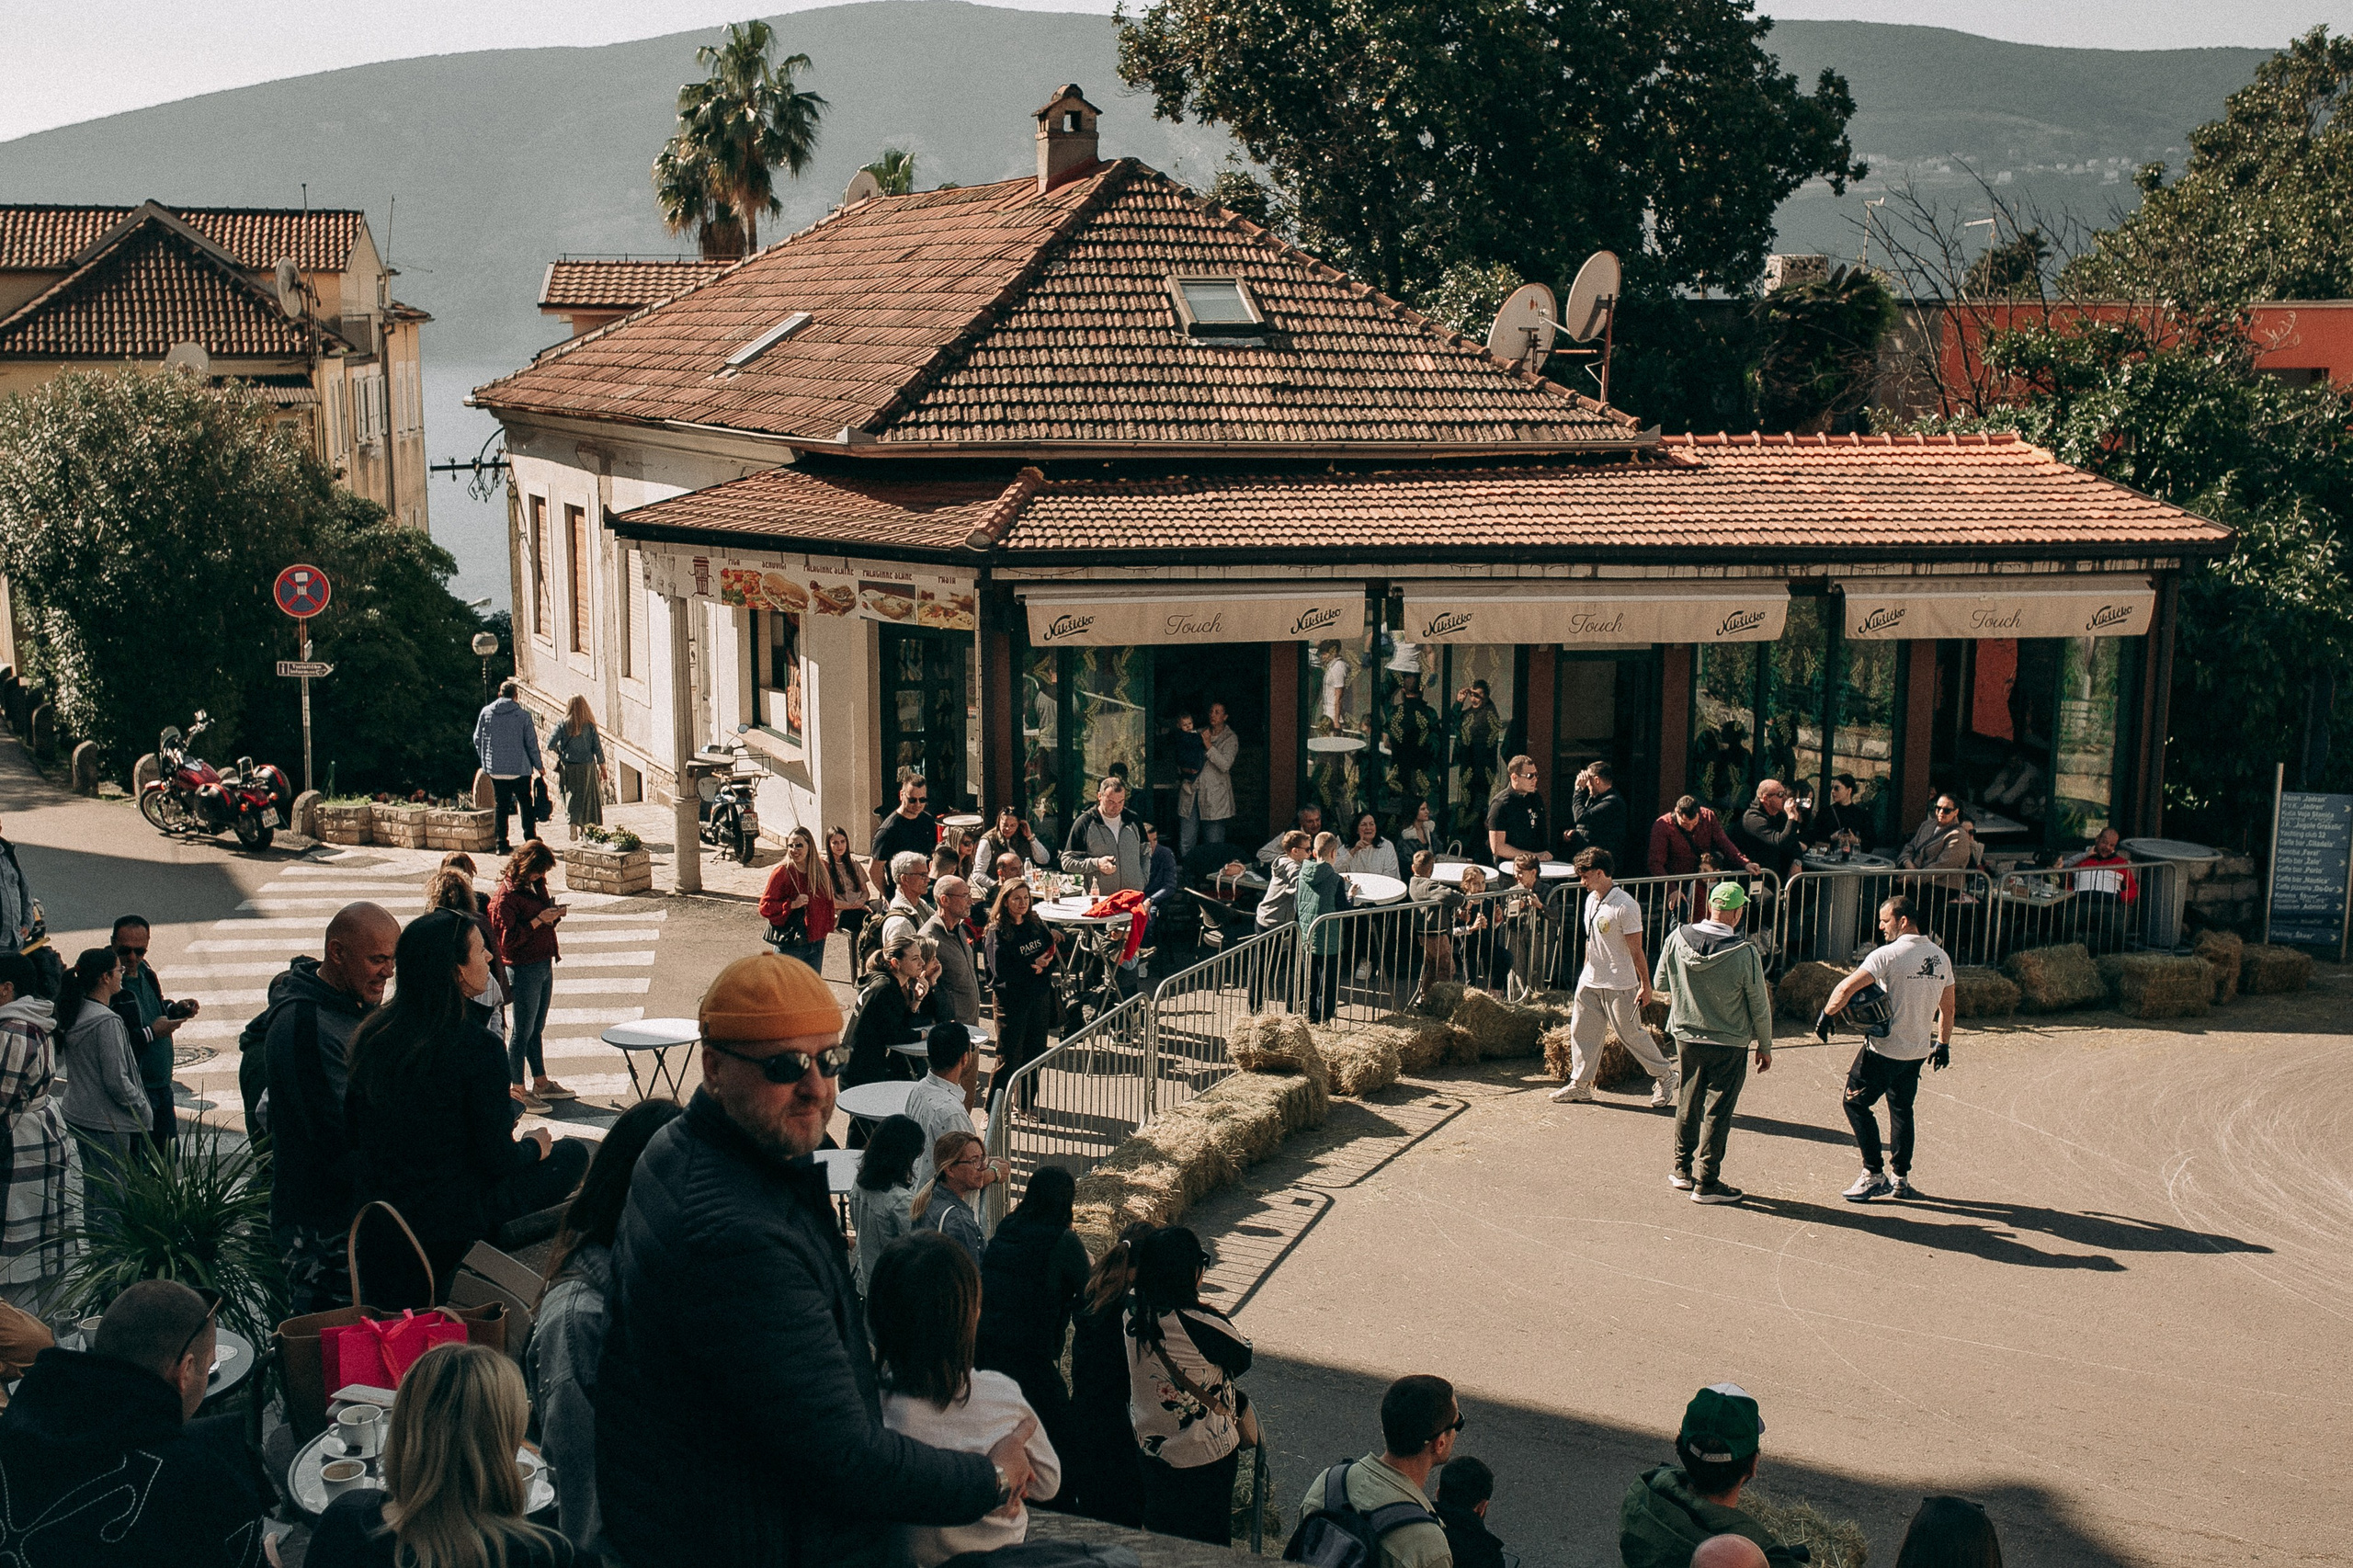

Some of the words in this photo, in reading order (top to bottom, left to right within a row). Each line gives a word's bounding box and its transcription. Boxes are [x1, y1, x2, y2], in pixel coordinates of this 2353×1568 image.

[1164, 612, 1222, 636] Touch
[1567, 613, 1624, 634] Touch
[1971, 608, 2021, 630] Touch
[1019, 938, 1042, 955] PARIS
